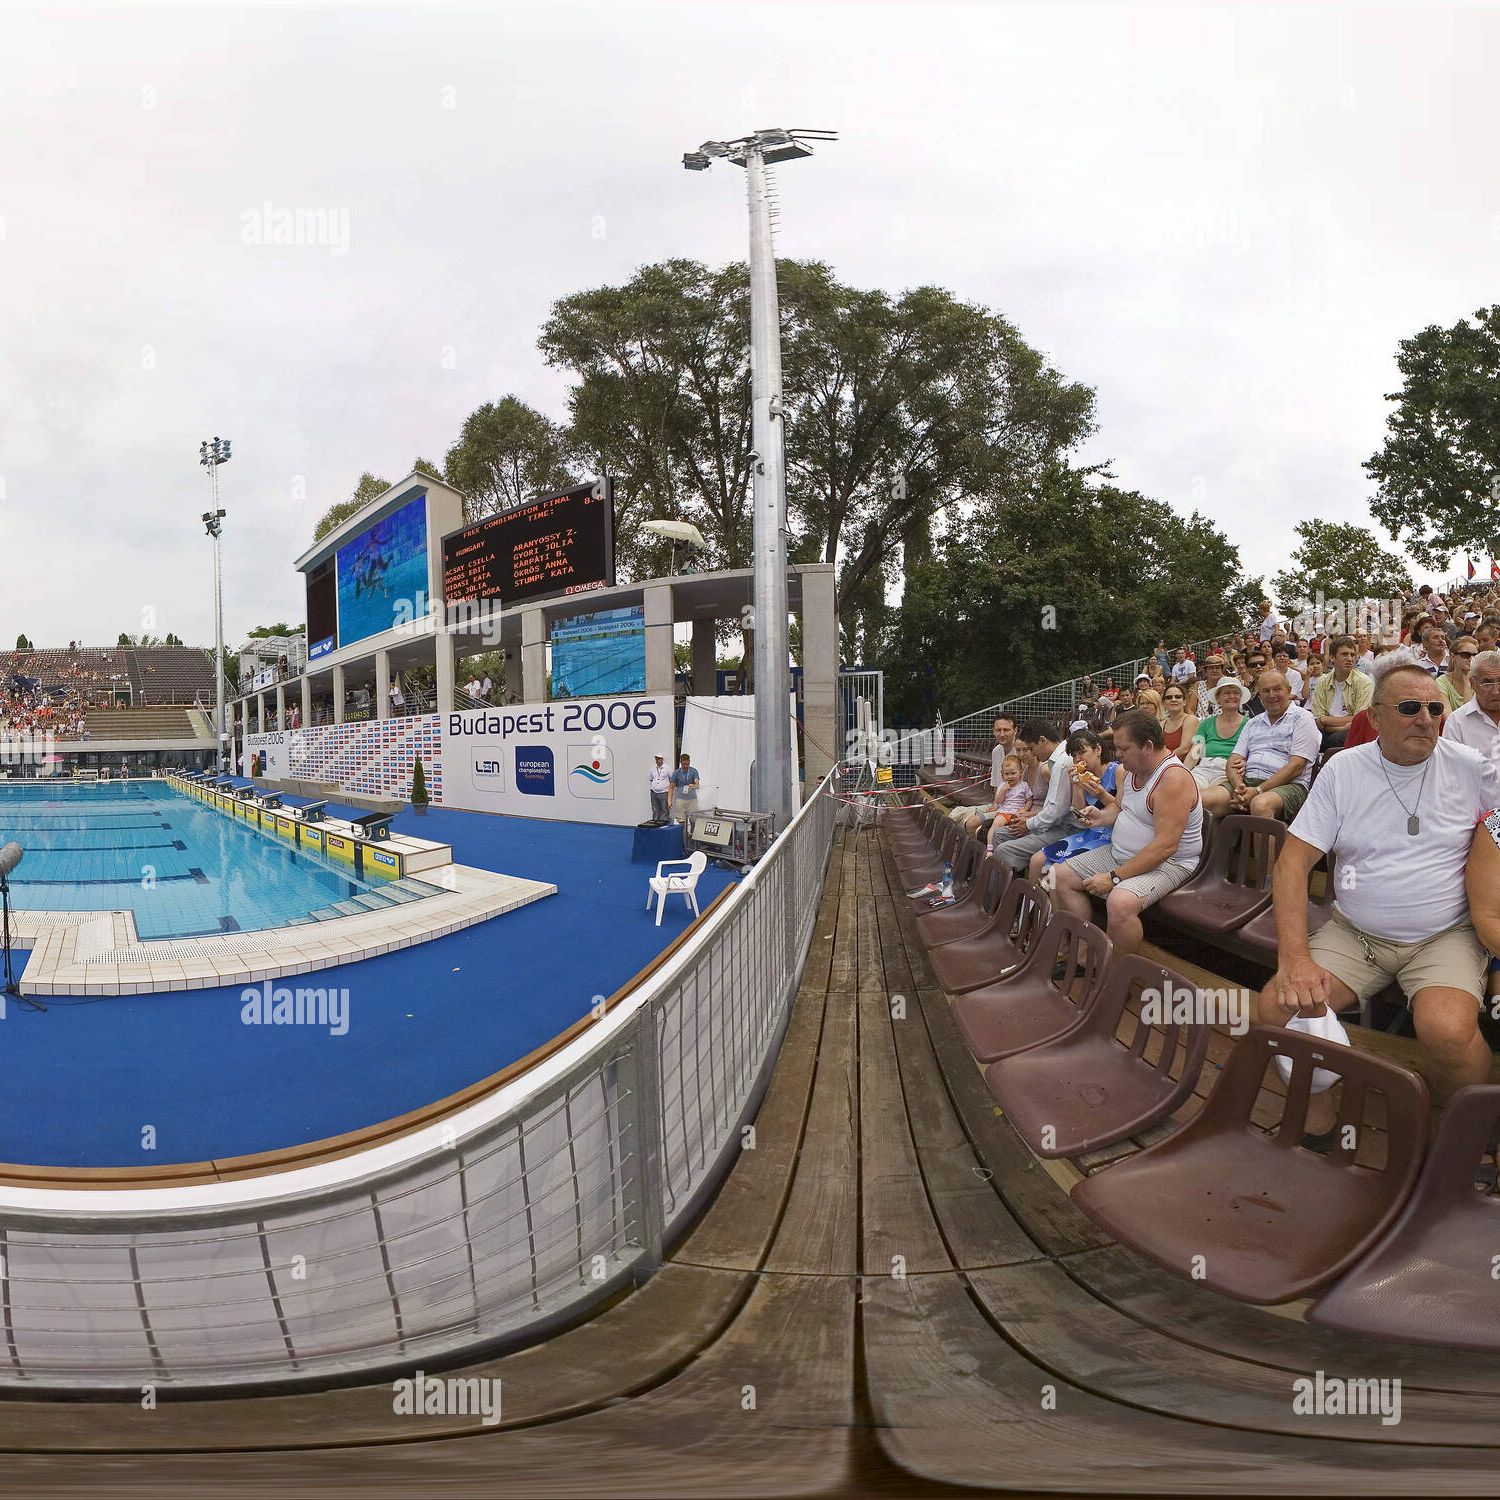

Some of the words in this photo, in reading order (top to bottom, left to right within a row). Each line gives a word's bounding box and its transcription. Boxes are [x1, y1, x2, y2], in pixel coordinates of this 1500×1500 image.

[463, 527, 480, 539] FREE
[483, 505, 539, 530] COMBINATION
[543, 495, 571, 509] FINAL
[528, 509, 555, 522] TIME:
[513, 531, 561, 552] ARANYOSSY
[455, 541, 485, 557] HUNGARY
[467, 553, 496, 568] CSILLA
[544, 557, 568, 570] ANNA
[468, 565, 486, 576] EDIT
[473, 571, 491, 582] KATA
[514, 572, 545, 587] STUMPF
[550, 565, 574, 577] KATA
[575, 581, 605, 593] OMEGA
[450, 706, 555, 739] Budapest
[563, 700, 657, 732] 2006
[268, 732, 285, 745] 2006
[475, 760, 500, 773] LEN
[315, 811, 319, 819] 1
[379, 827, 386, 837] 0
